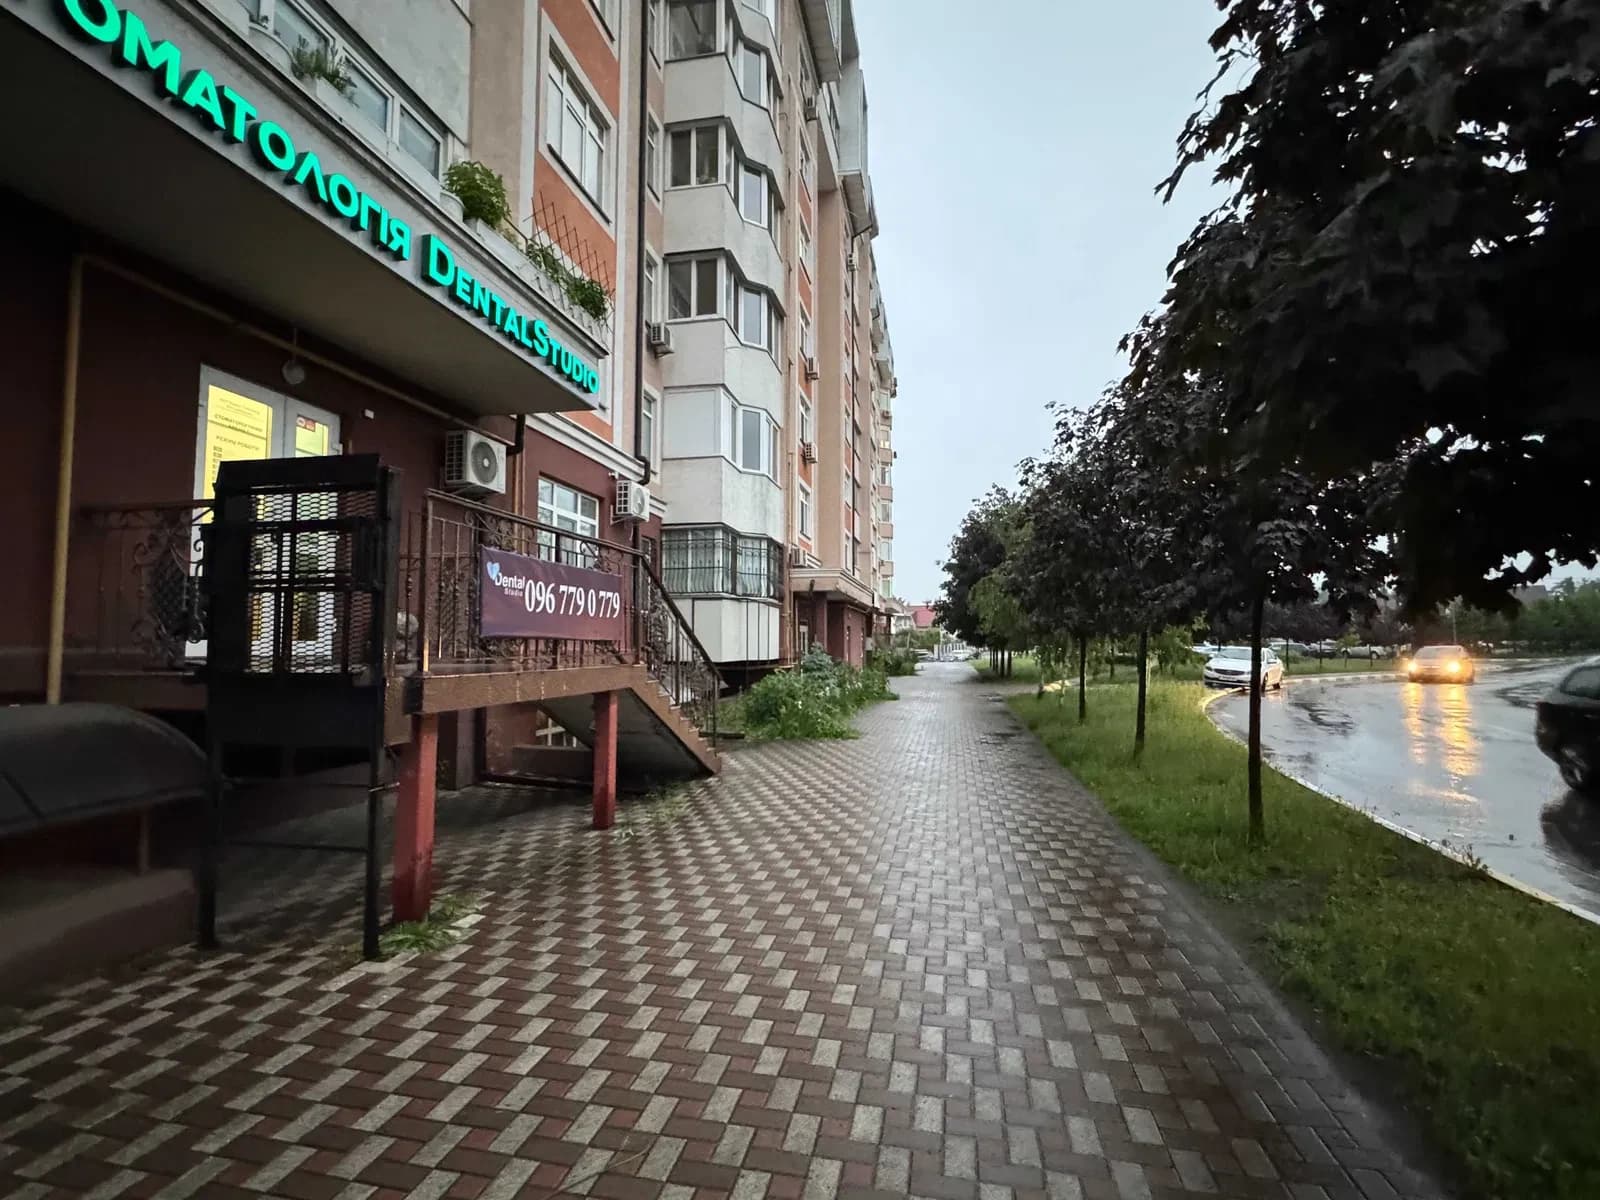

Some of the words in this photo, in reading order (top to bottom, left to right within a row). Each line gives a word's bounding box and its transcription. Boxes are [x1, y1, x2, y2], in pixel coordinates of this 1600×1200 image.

[495, 573, 525, 589] Dental
[525, 580, 555, 614] 096
[559, 585, 585, 615] 779
[588, 589, 596, 616] 0
[599, 591, 620, 618] 779
